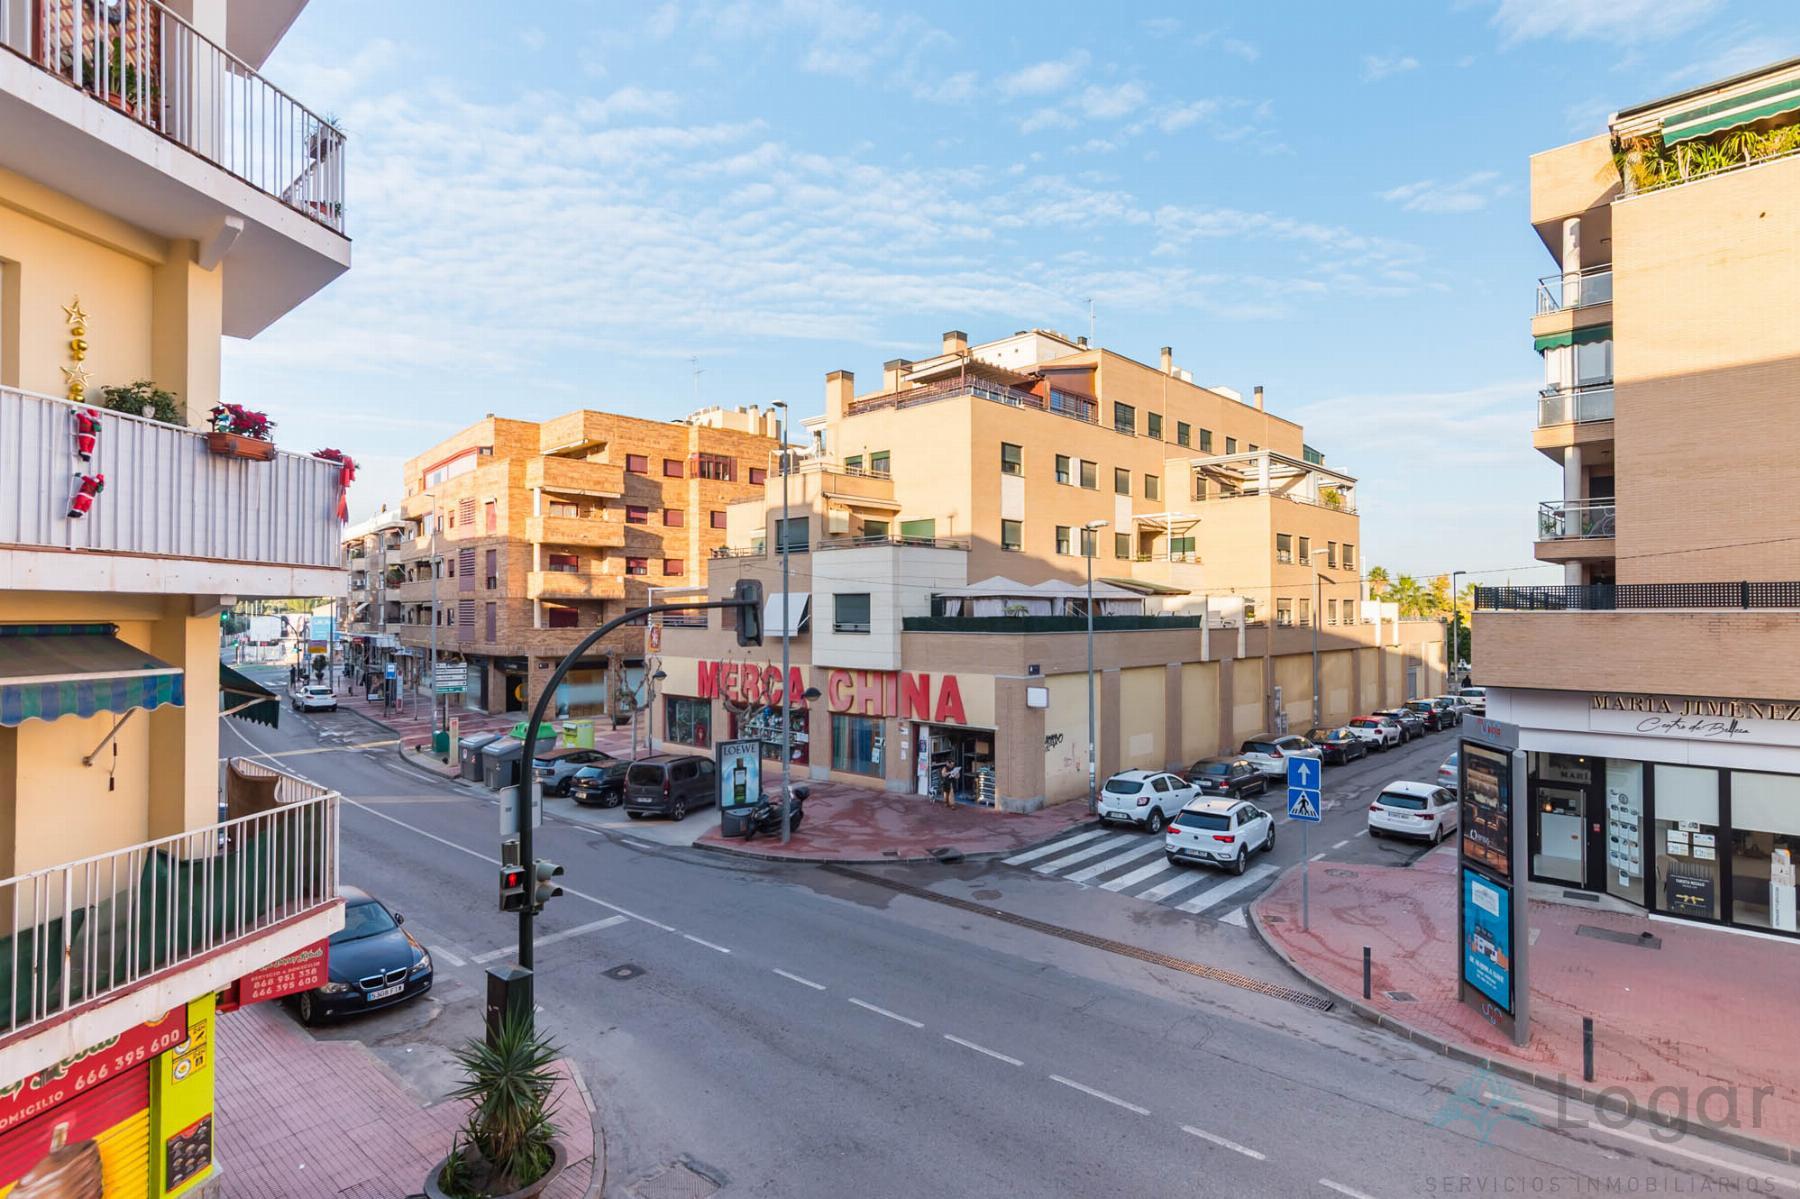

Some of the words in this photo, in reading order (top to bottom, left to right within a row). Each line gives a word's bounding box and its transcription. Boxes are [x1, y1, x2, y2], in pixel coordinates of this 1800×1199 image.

[697, 660, 810, 708] MERCA
[828, 669, 967, 725] CHINA
[1591, 695, 1673, 714] MARÍA
[1680, 698, 1800, 722] JIMÉNEZ
[1636, 716, 1685, 733] Centro
[1688, 720, 1703, 733] de
[1704, 718, 1751, 738] Belleza
[723, 743, 758, 756] LOEWE
[252, 988, 273, 999] 666
[275, 981, 296, 993] 395
[298, 975, 318, 987] 600
[74, 1063, 109, 1091] 666
[115, 1045, 145, 1071] 395
[150, 1029, 181, 1053] 600
